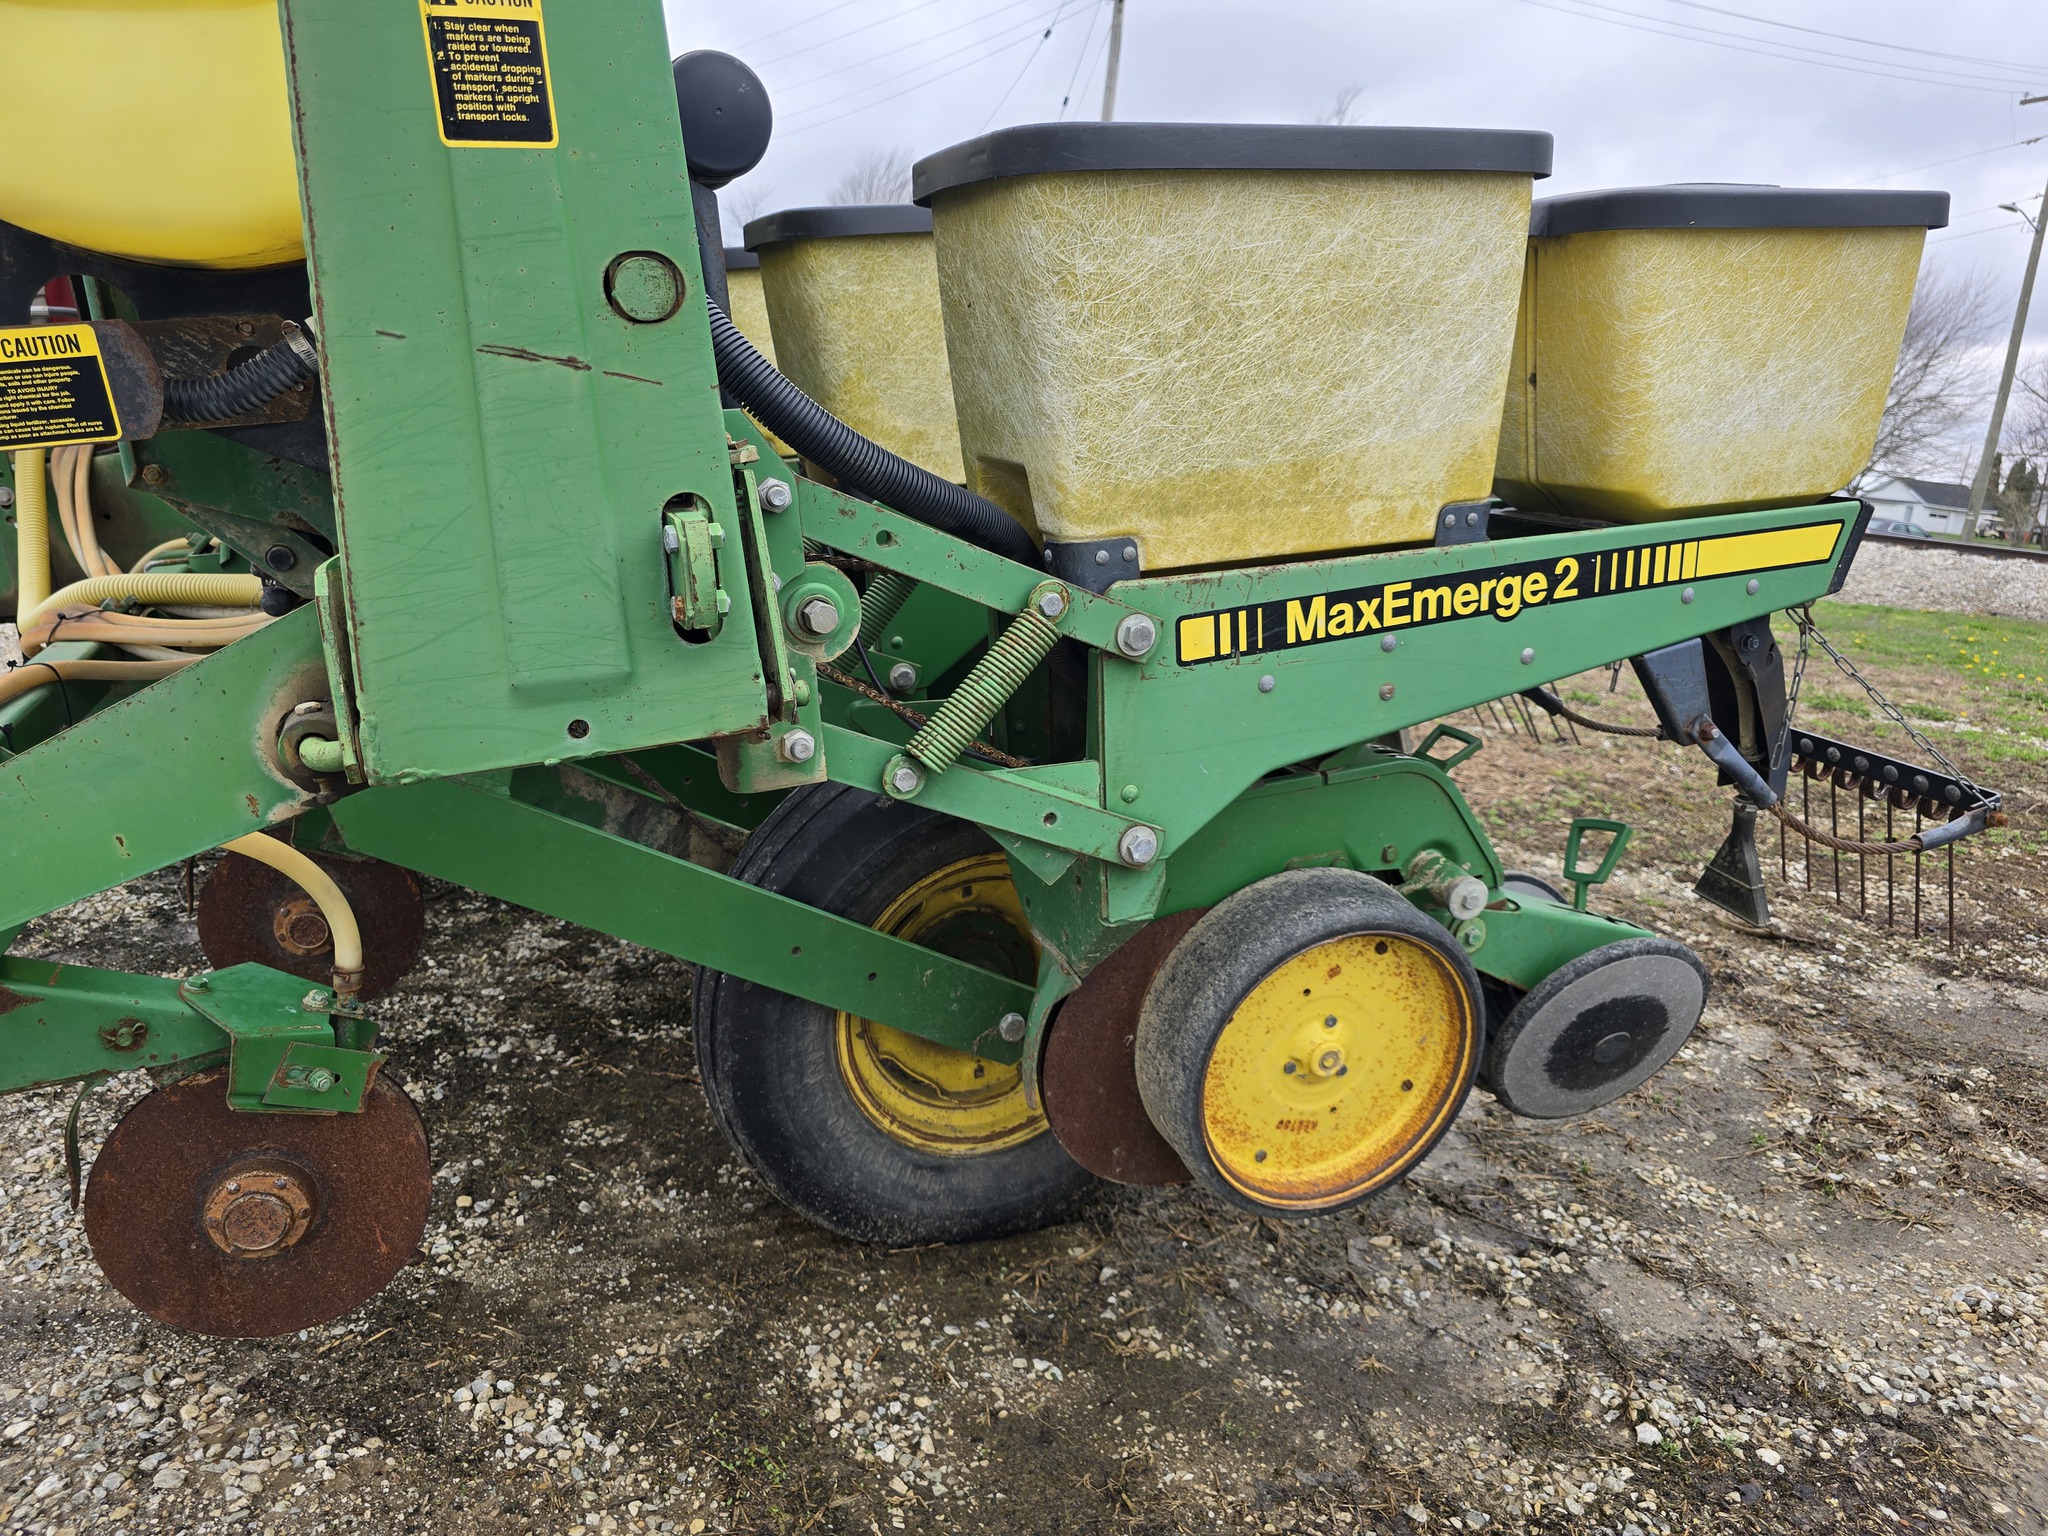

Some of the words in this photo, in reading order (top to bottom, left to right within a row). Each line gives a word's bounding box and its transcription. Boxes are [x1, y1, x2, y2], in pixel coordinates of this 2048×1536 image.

[444, 21, 464, 32] Stay
[495, 25, 519, 33] when
[505, 35, 530, 45] being
[448, 43, 476, 51] raised
[493, 43, 532, 53] lowered.
[437, 51, 445, 60] 2.
[448, 52, 461, 60] To
[464, 54, 500, 62] prevent
[451, 63, 498, 71] accidental
[501, 64, 541, 74] dropping
[452, 72, 462, 80] of
[465, 73, 502, 82] markers
[505, 73, 534, 84] during
[453, 83, 498, 92] transport,
[507, 94, 539, 104] upright
[456, 103, 493, 112] position
[458, 112, 499, 122] transport
[503, 112, 529, 121] locks.
[0, 334, 81, 358] CAUTION
[1287, 572, 1547, 644] MaxEmerge
[1553, 557, 1579, 598] 2
